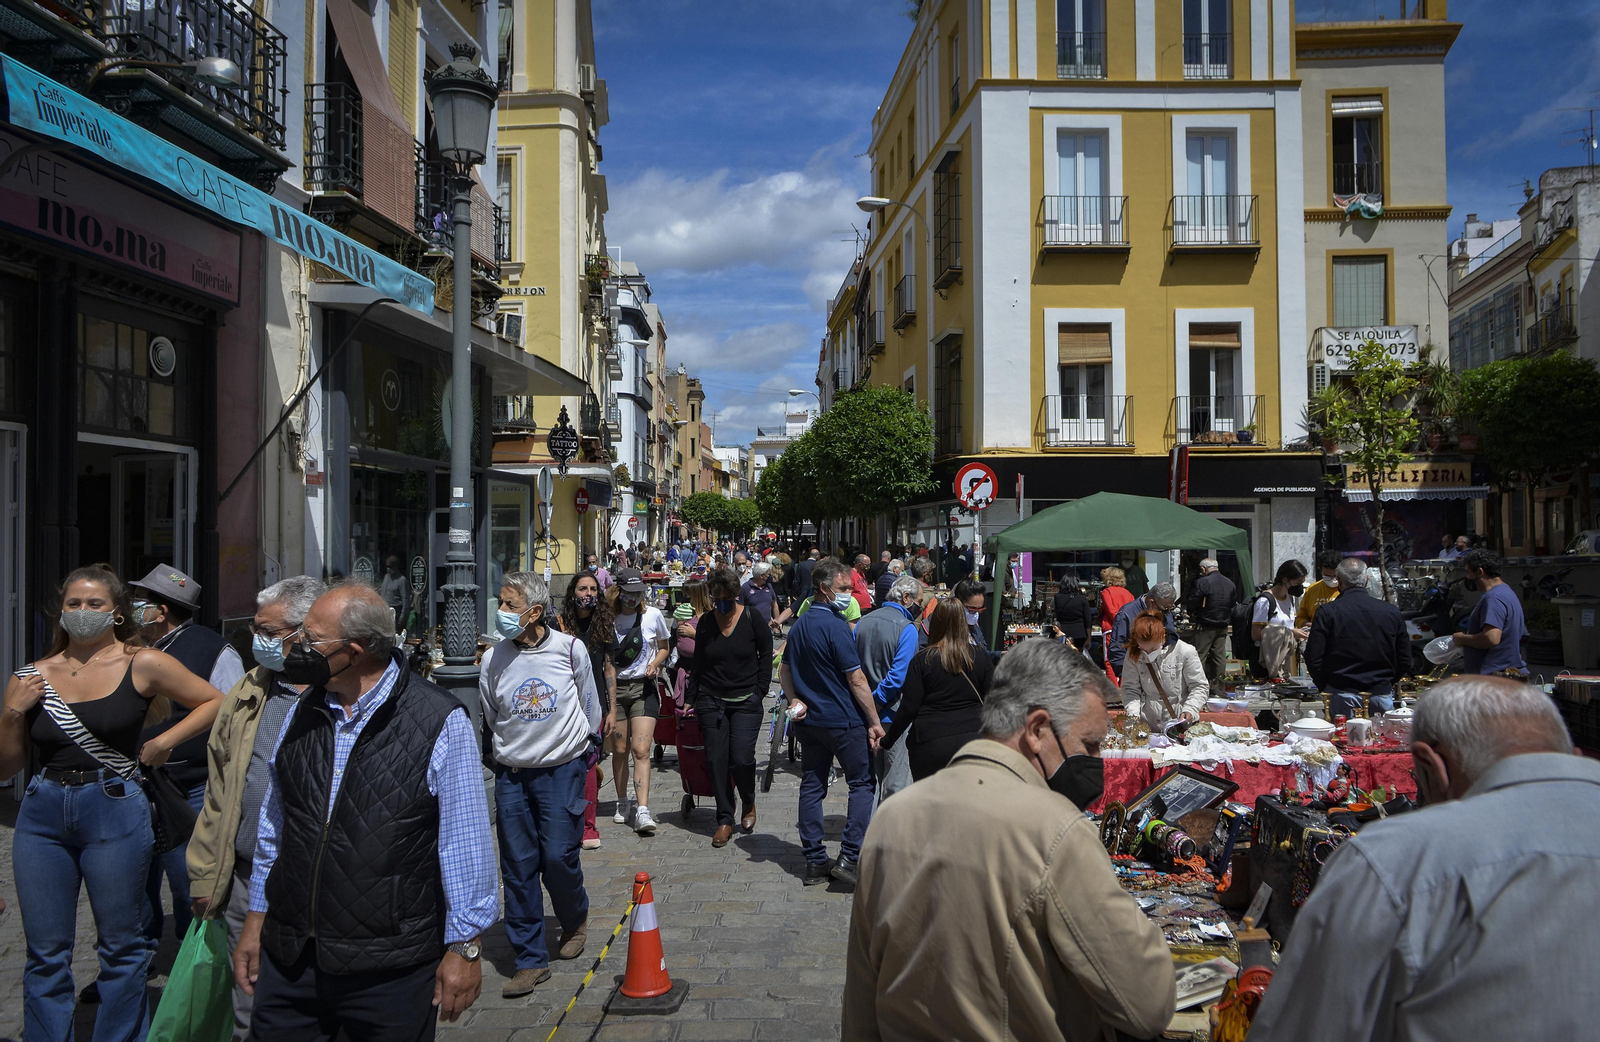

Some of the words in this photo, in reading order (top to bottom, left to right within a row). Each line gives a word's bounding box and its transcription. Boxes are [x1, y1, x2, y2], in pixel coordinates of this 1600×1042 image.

[32, 88, 113, 150] Imperiale
[35, 196, 167, 272] mo.ma
[177, 156, 257, 225] CAFE
[269, 203, 376, 287] mo.ma
[191, 264, 232, 294] Imperiale
[1337, 331, 1350, 341] SE
[1353, 330, 1402, 341] ALQUILA
[1389, 342, 1416, 355] 073
[550, 439, 578, 448] TATTOO
